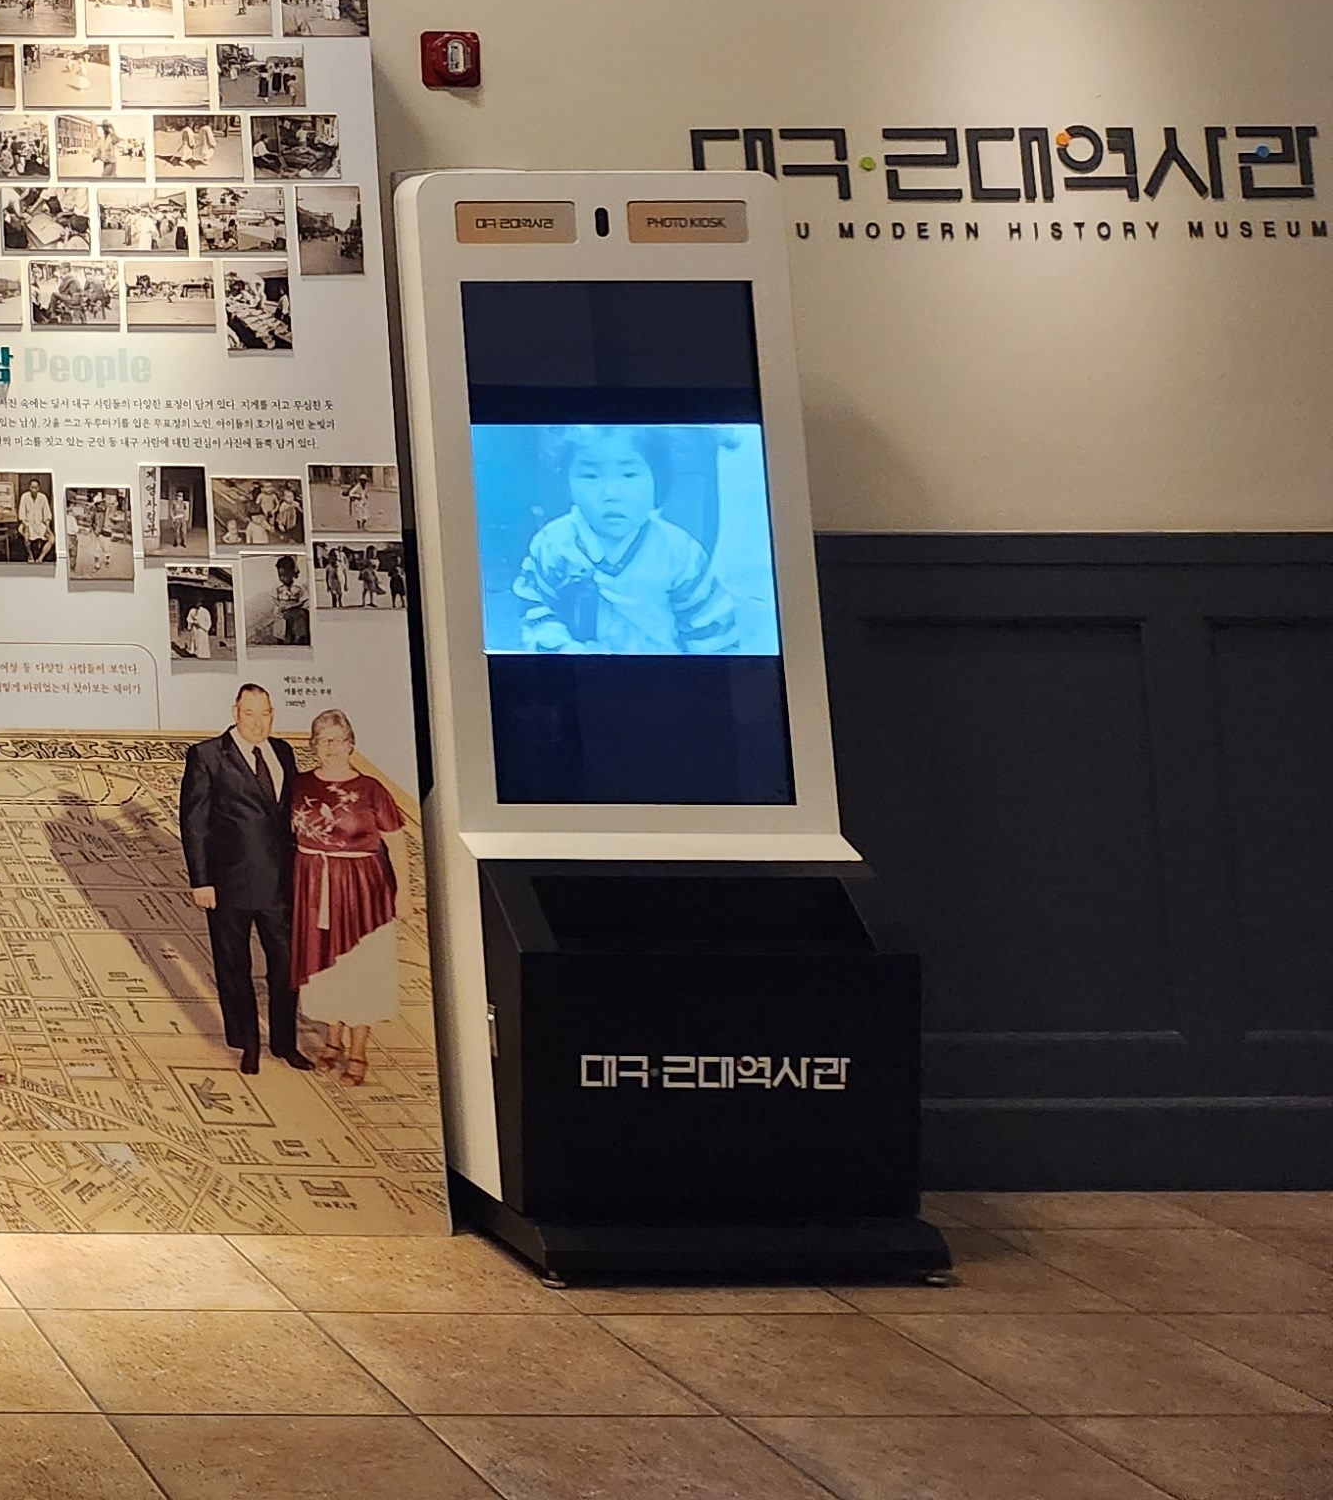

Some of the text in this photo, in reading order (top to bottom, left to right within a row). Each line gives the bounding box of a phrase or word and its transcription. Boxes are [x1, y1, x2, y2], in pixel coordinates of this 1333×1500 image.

[647, 218, 726, 228] PHOTO KIOSK
[839, 219, 1329, 241] MODERN HISTORY MUSEUM
[24, 347, 152, 388] People
